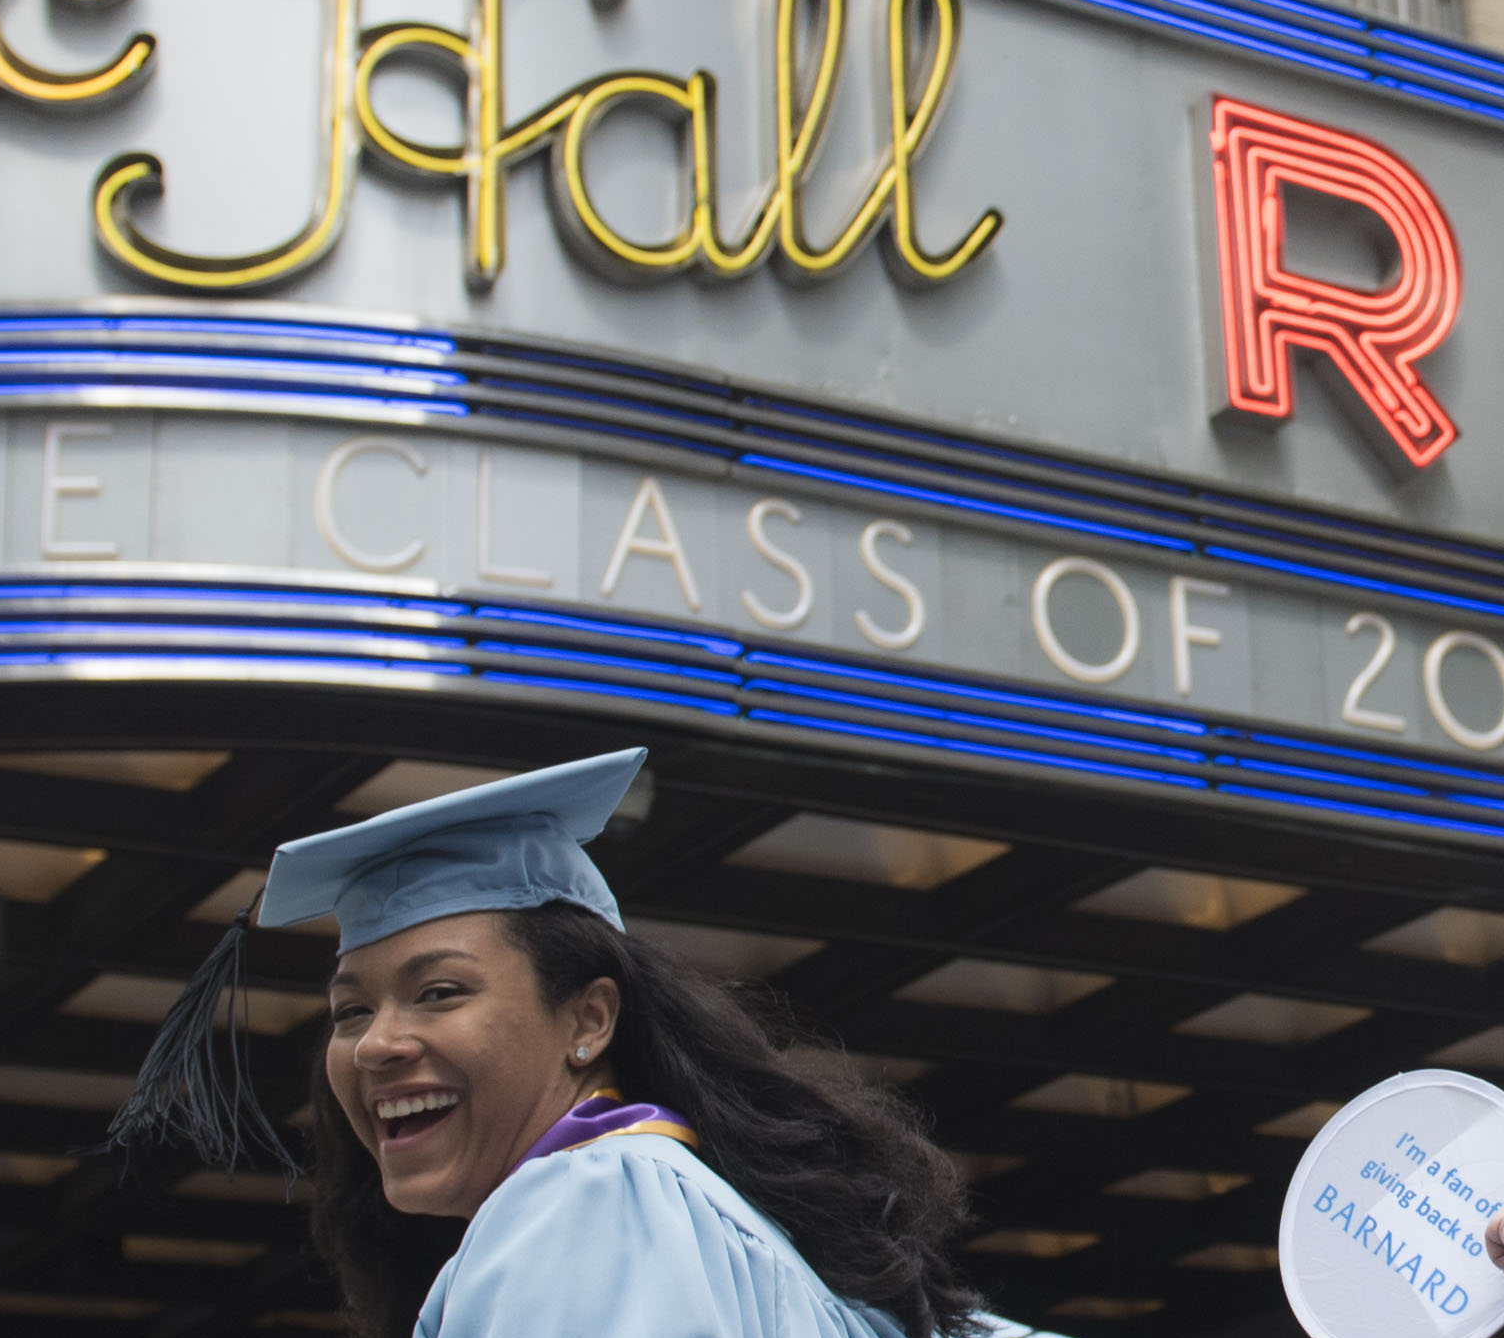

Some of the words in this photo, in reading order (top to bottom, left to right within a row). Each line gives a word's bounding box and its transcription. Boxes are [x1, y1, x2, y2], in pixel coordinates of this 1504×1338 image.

[314, 435, 926, 650] CLASS
[1030, 555, 1232, 695] OF
[1360, 1160, 1417, 1209] giving
[1416, 1196, 1462, 1241] back
[1461, 1232, 1483, 1258] to
[1396, 1132, 1427, 1165] I'm
[1426, 1161, 1441, 1177] a
[1441, 1168, 1474, 1202] fan
[1475, 1202, 1503, 1219] of
[1312, 1183, 1469, 1316] BARNARD
